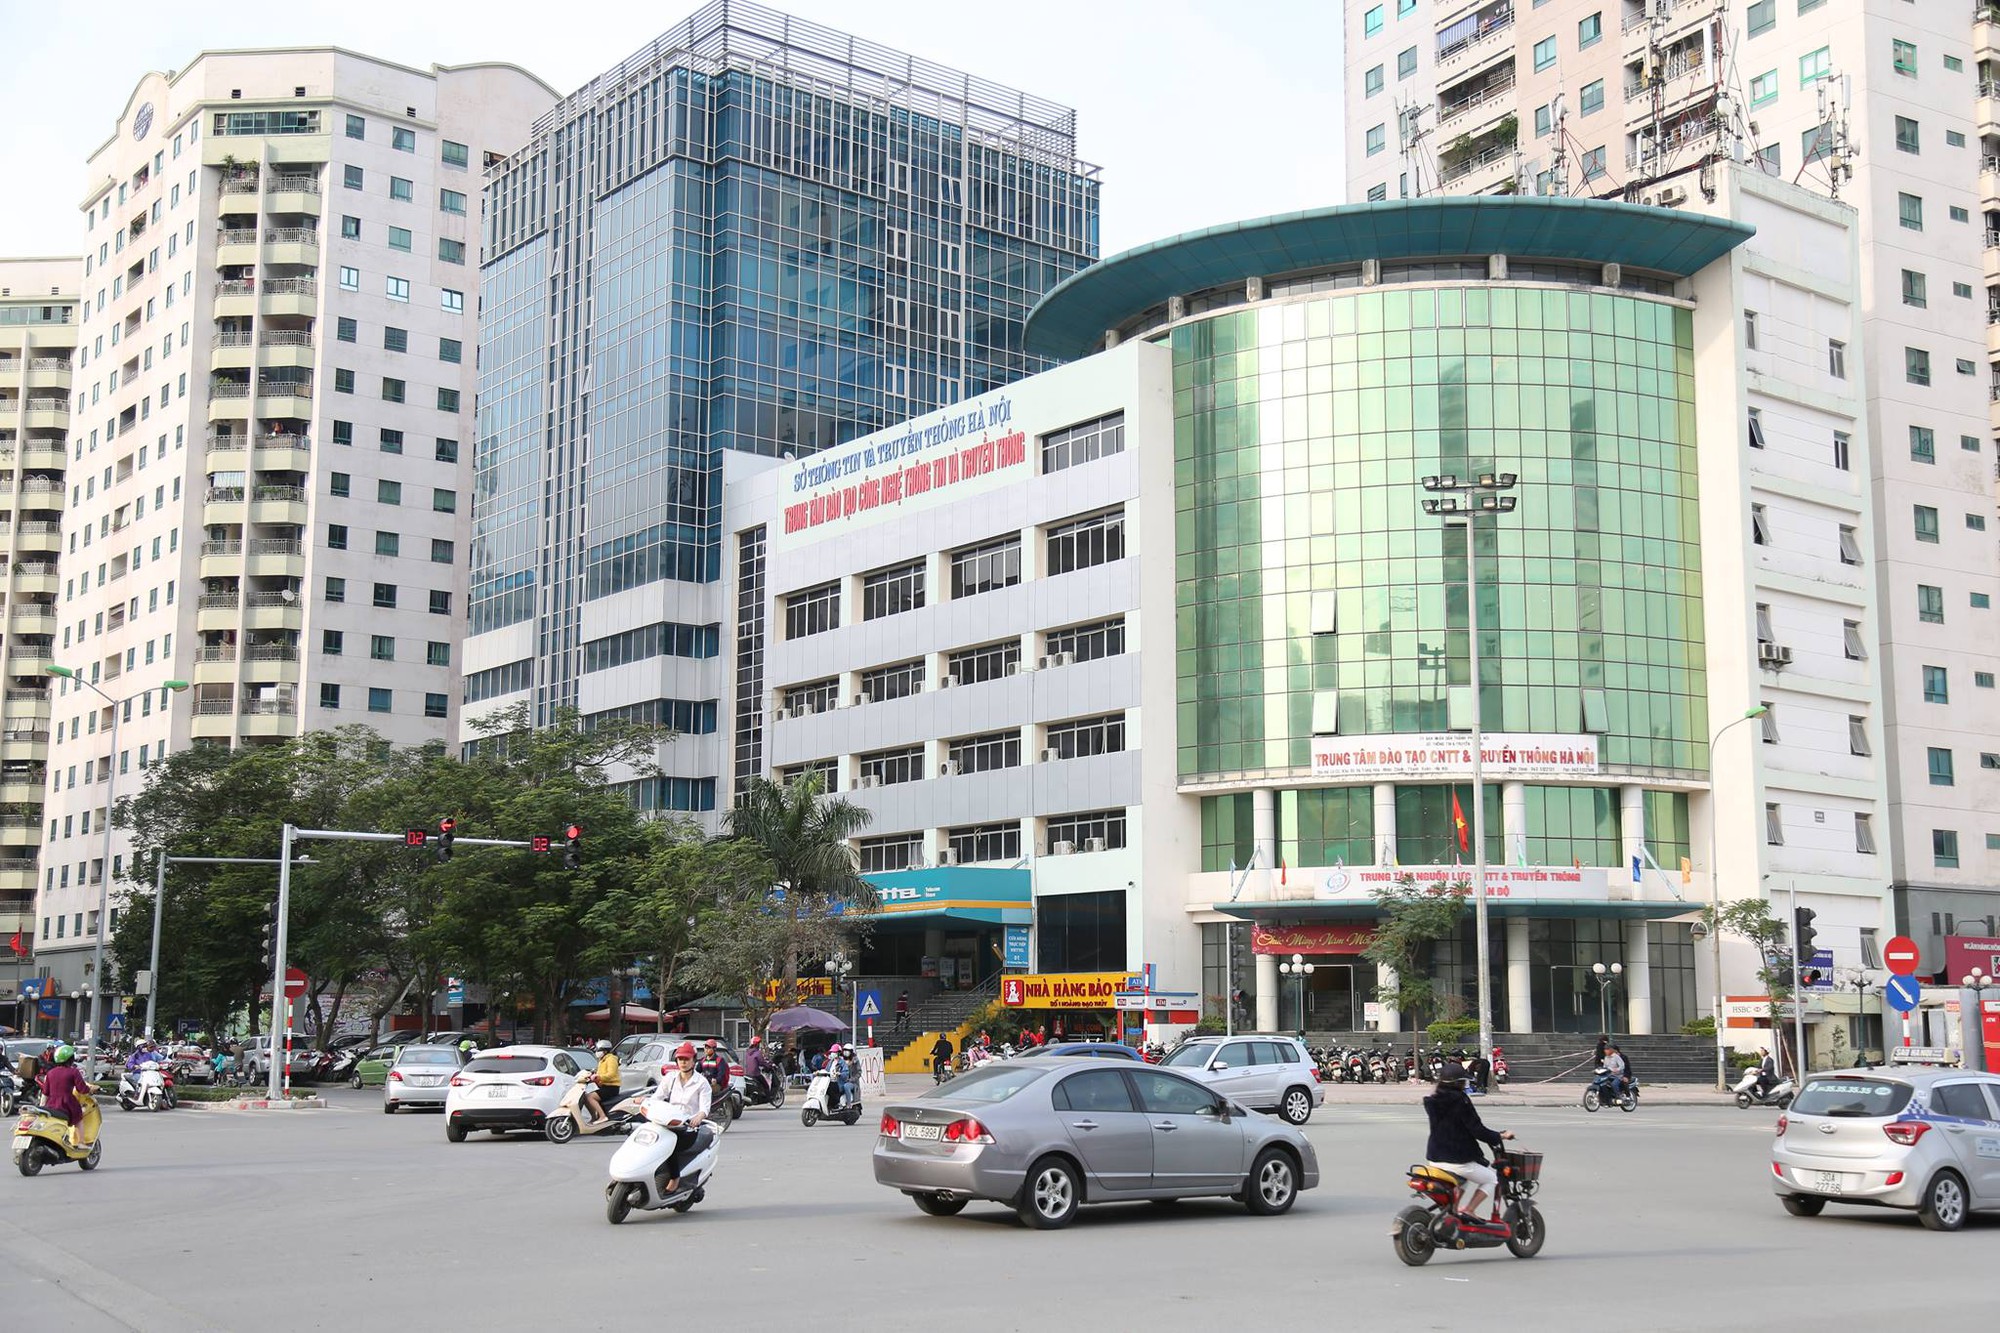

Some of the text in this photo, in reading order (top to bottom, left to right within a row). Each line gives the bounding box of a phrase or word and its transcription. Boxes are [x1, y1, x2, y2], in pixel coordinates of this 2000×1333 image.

[794, 395, 1012, 492] SỞ THÔNG TIN VÀ TRUYỀN THÔNG HÀ NỘI
[784, 428, 1026, 535] TRUNG TÂM ĐÀO TẠO CÔNG NGHỆ THÔNG TIN VÀ TRUYỀN THÔNG
[1315, 744, 1595, 767] TRUNG TÂM ĐÀO TẠO CNTT & RUYỀN THÔNG HÀ NỘI
[1360, 872, 1391, 882] TRUNG
[1416, 869, 1450, 881] NGUỒN
[1452, 871, 1471, 881] LỰC
[1501, 873, 1509, 881] &
[1511, 869, 1547, 881] TRUYỀN
[1550, 871, 1580, 882] THÔNG
[1026, 978, 1050, 998] NHÀ
[1053, 978, 1087, 998] HÀNG
[1088, 978, 1113, 997] BẢO
[1114, 977, 1126, 993] TÍ
